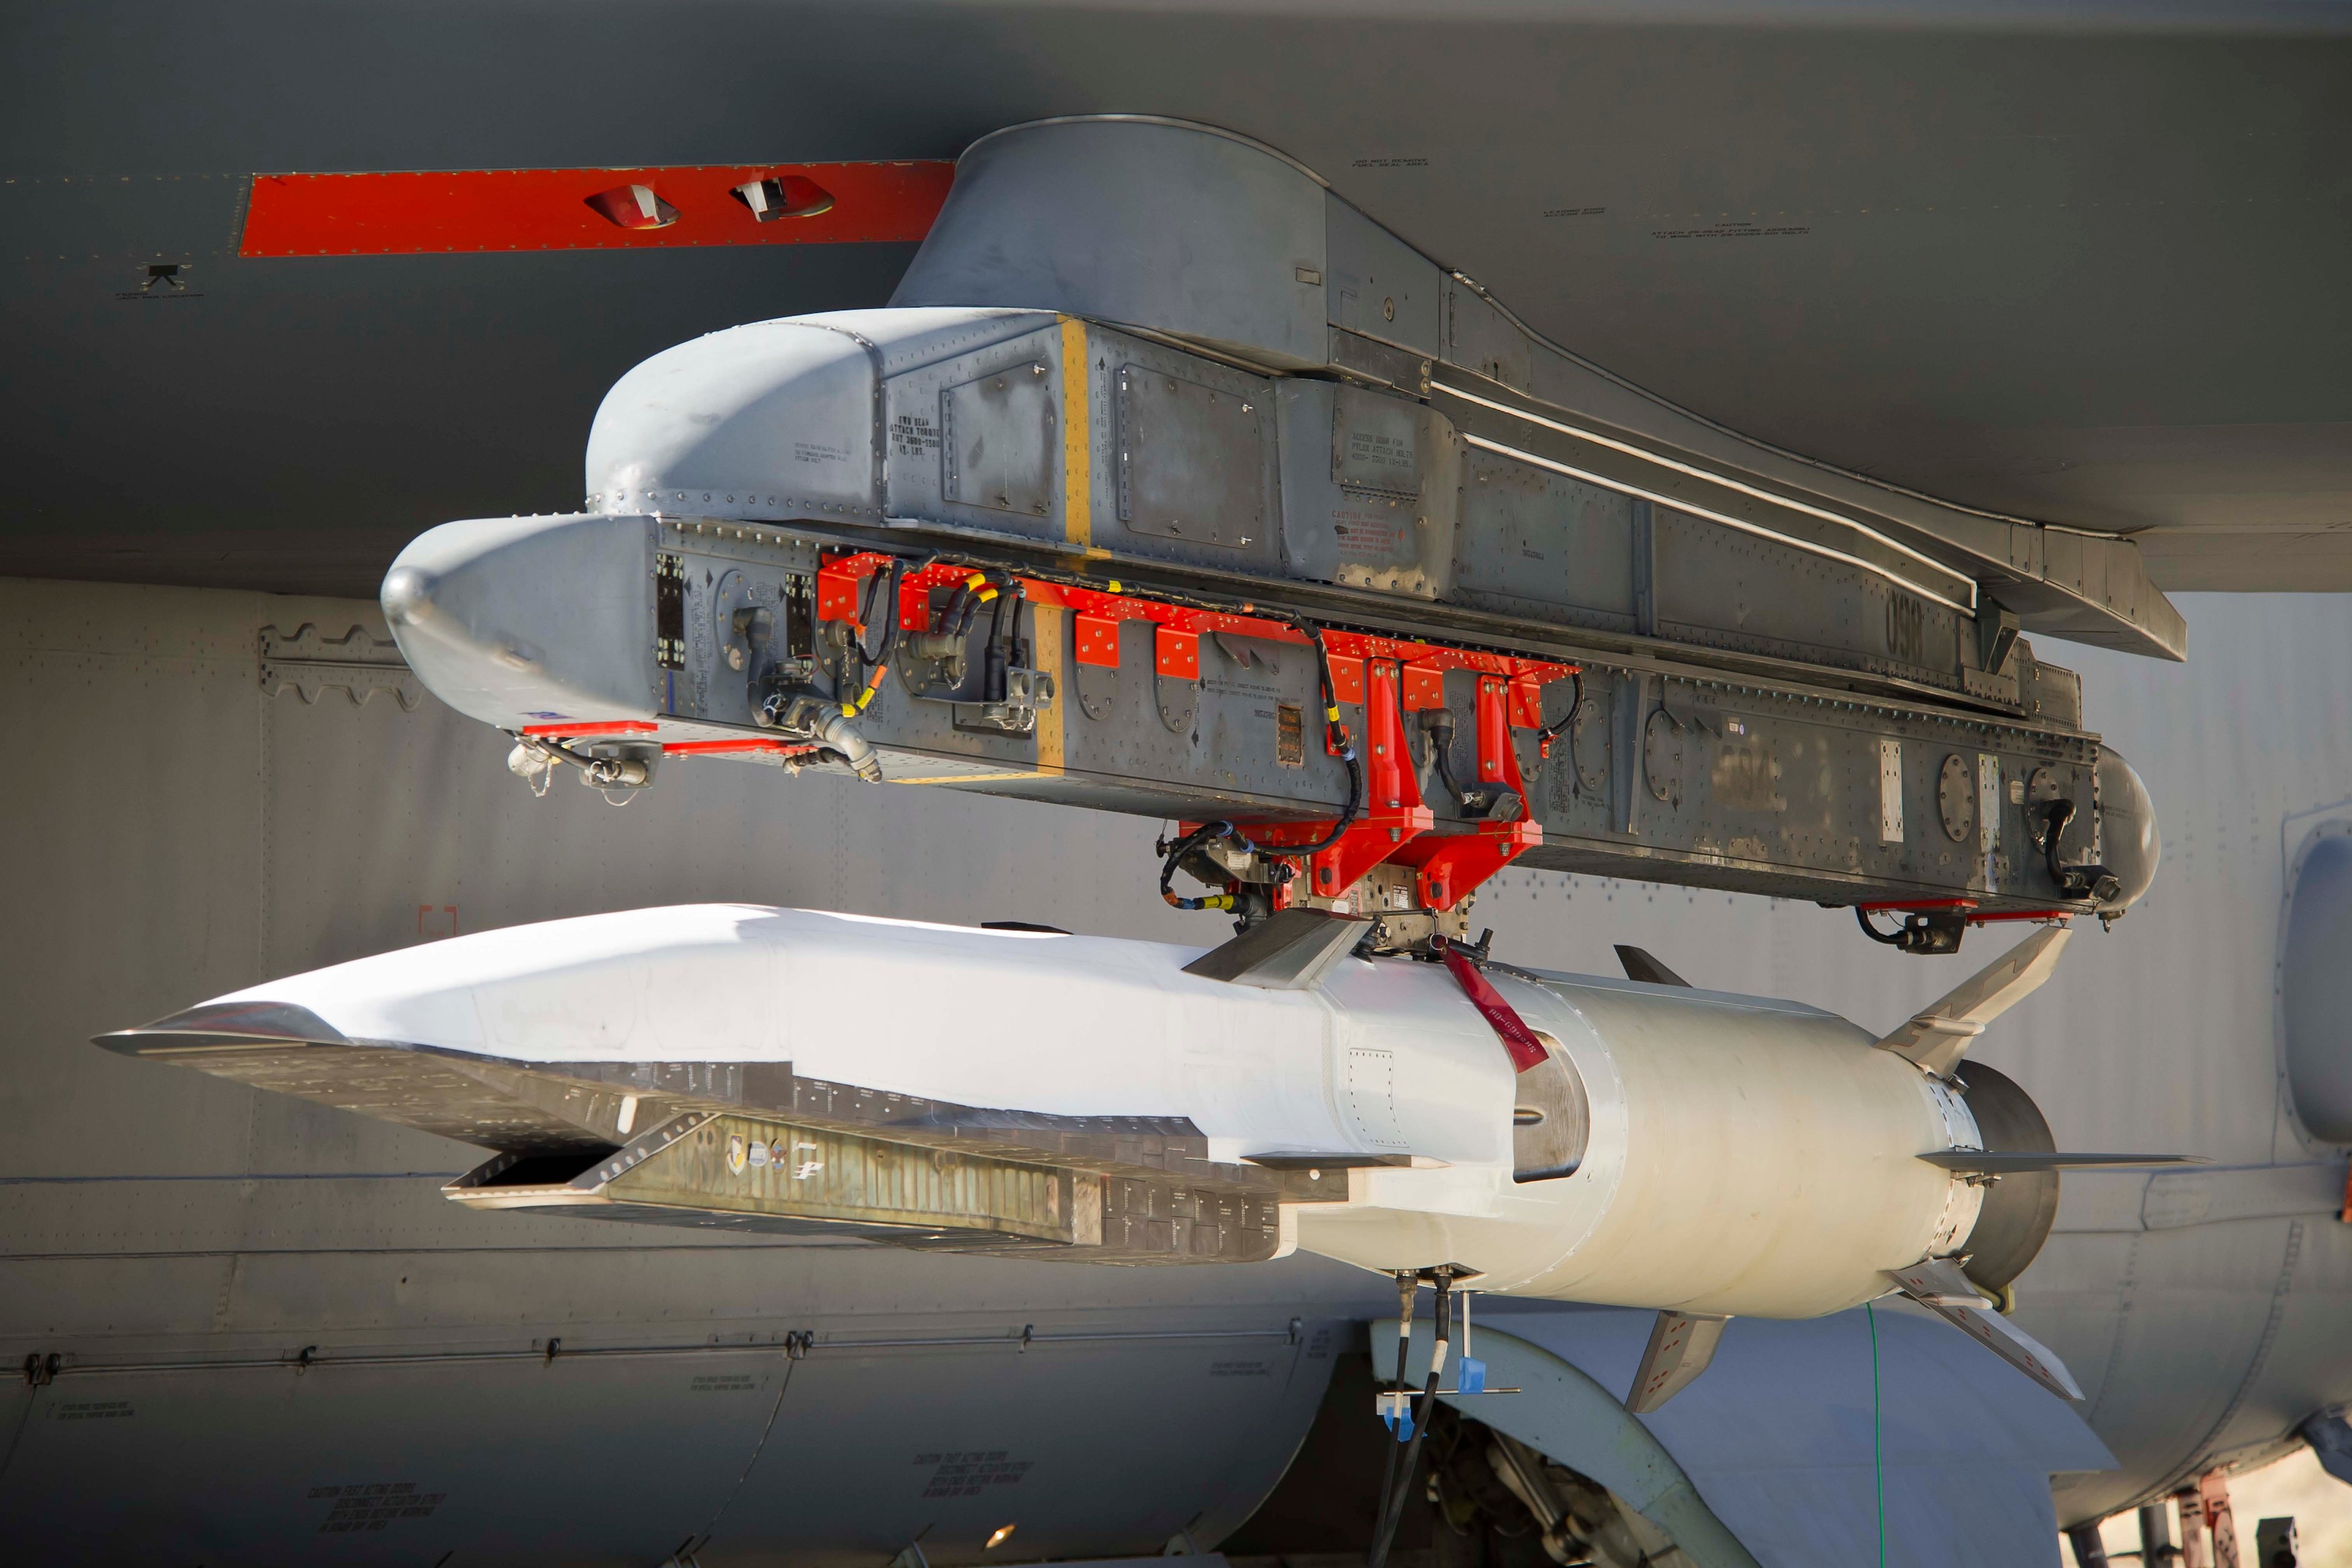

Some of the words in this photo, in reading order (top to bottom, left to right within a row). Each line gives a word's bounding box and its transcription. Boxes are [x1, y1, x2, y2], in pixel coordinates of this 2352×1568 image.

[899, 416, 911, 425] FWD
[891, 424, 913, 434] ATTACH
[916, 427, 940, 437] TORQUE
[1352, 432, 1373, 442] ACCESS
[1372, 445, 1393, 455] ATTACH
[1396, 450, 1412, 459] BOLTS
